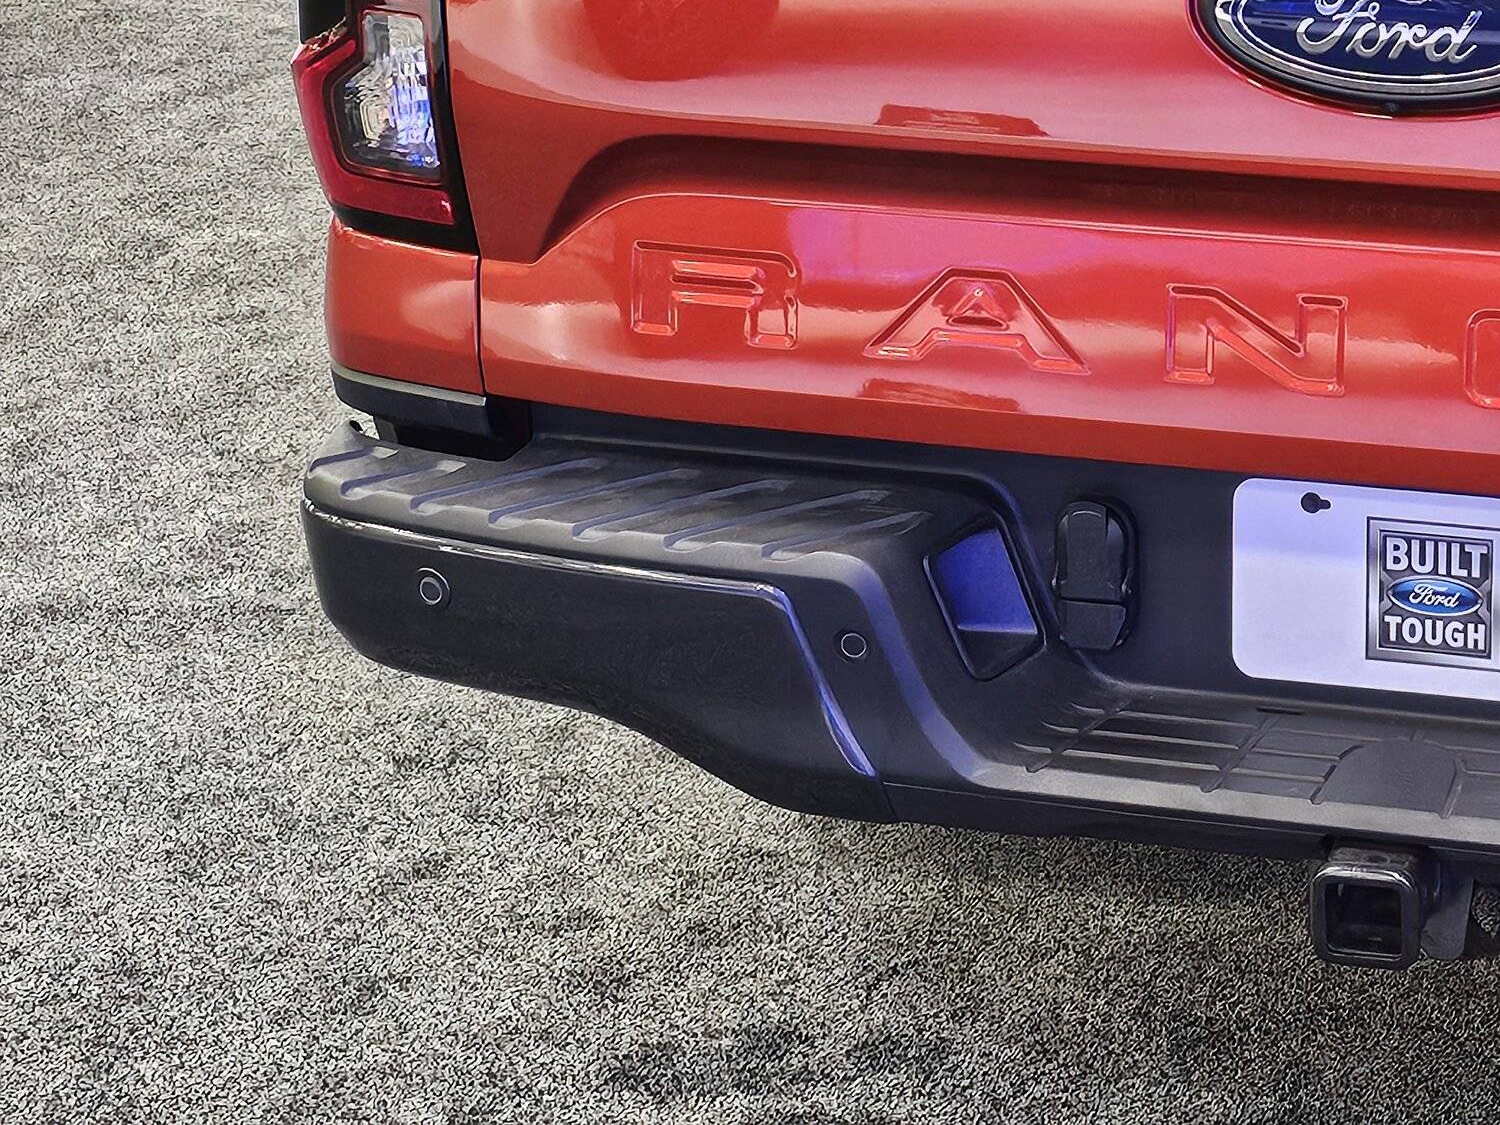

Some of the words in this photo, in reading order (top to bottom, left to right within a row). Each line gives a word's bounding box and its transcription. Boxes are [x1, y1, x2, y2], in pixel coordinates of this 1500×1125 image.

[1385, 536, 1489, 579] BUILT
[1408, 582, 1460, 610] Ford
[1383, 614, 1487, 651] TOUGH
